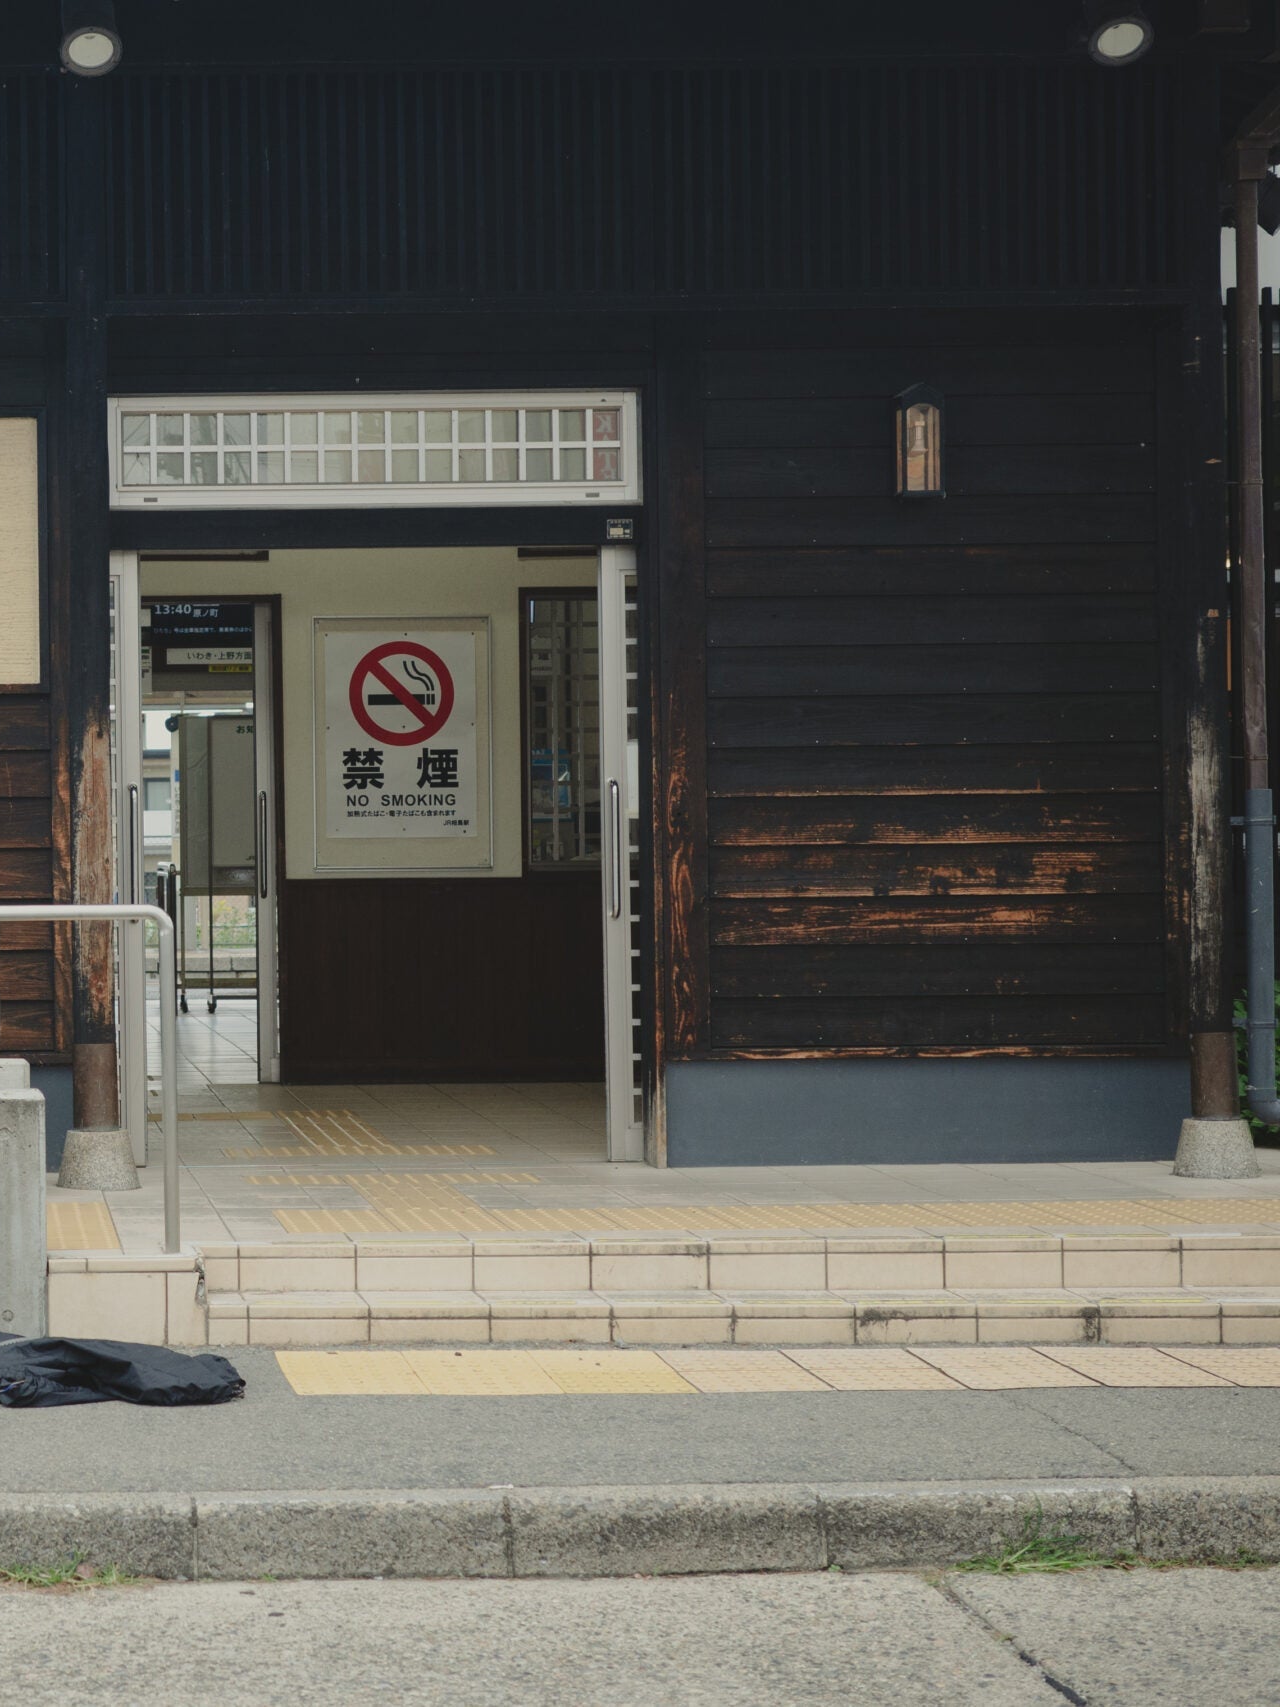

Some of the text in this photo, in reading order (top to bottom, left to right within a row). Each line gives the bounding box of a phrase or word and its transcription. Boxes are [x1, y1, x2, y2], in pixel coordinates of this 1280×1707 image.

[154, 604, 192, 615] 13:40
[346, 793, 457, 807] NO SMOKING
